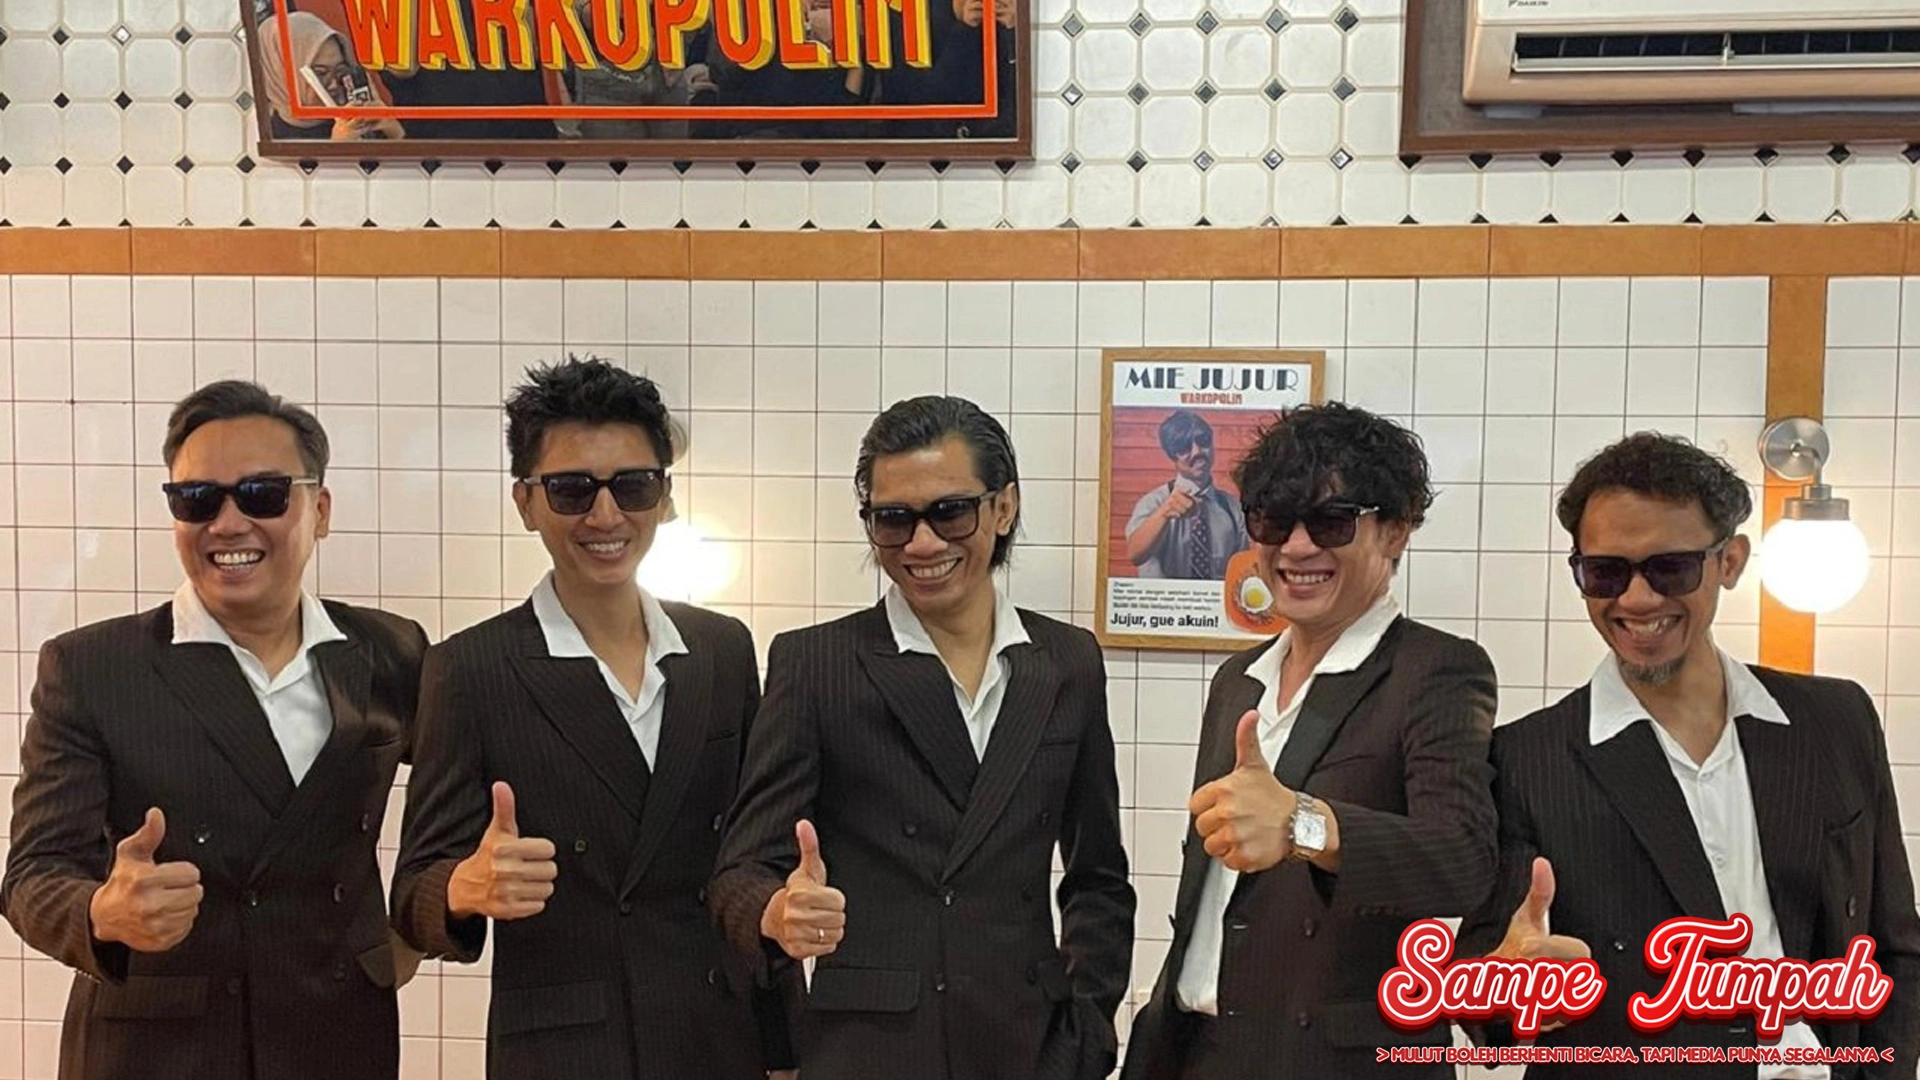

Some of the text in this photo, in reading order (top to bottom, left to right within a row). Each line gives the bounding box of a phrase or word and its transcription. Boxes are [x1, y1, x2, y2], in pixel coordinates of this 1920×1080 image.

[341, 0, 932, 71] WARKOPOLIM
[1125, 367, 1299, 391] MIE JUJUR
[1180, 392, 1243, 404] WARKOPOLIM
[1111, 613, 1218, 628] Jujur, gue akuin!
